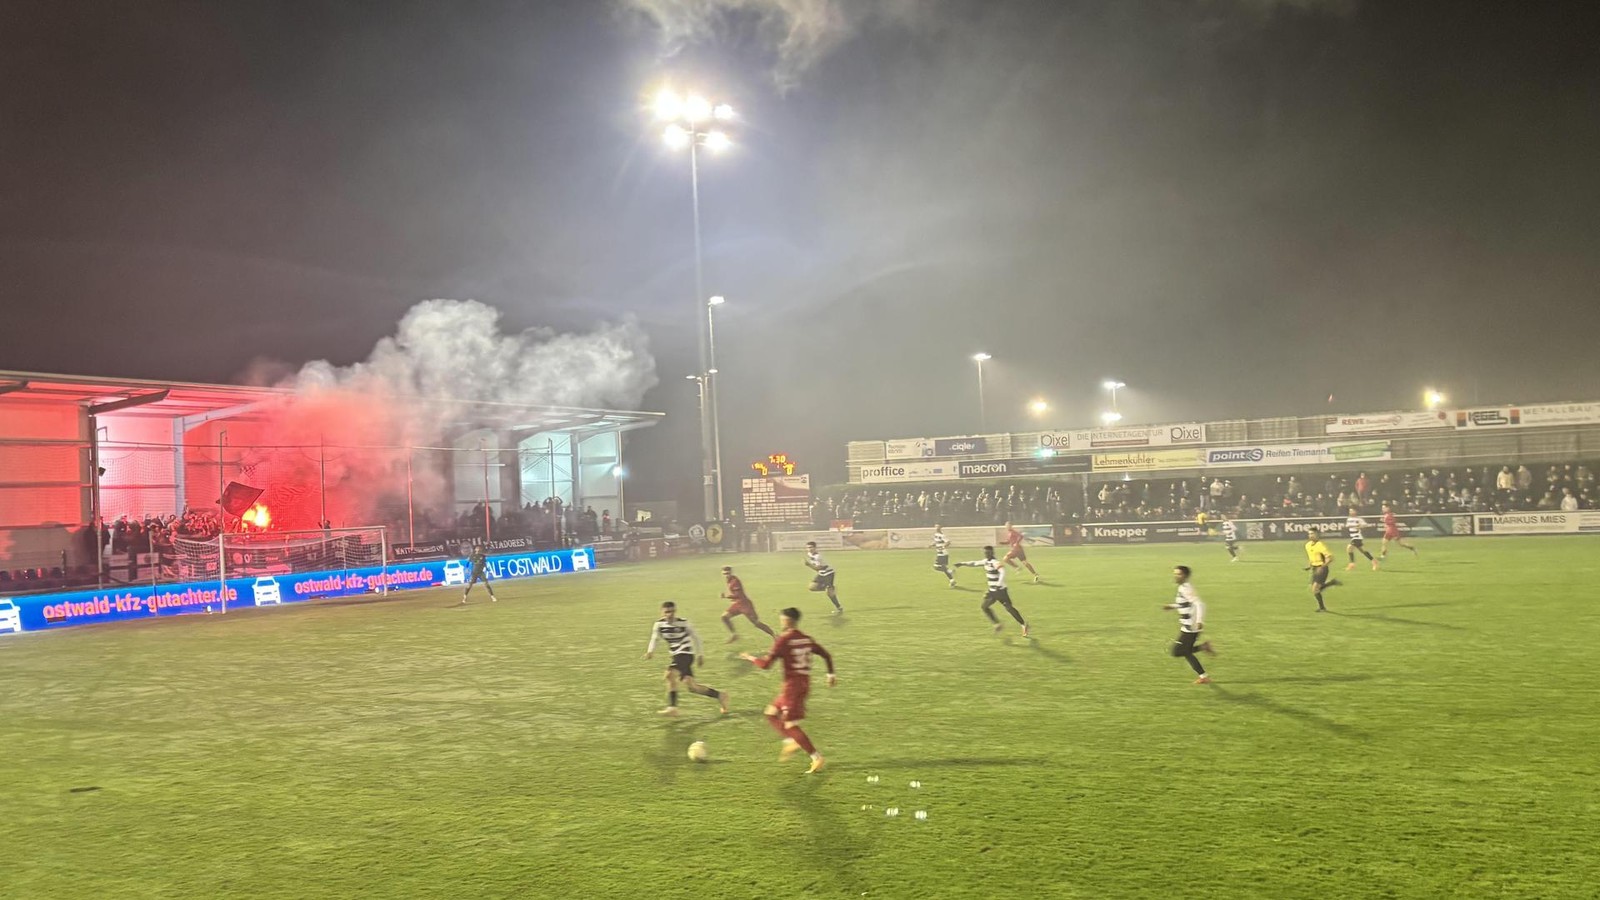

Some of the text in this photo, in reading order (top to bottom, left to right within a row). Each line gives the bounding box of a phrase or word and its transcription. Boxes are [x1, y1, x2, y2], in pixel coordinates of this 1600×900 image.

[1266, 449, 1291, 459] Reifen
[1293, 448, 1327, 457] Tiemann
[862, 466, 905, 479] proffice
[962, 463, 1007, 474] macron
[1494, 514, 1566, 525] MARKUS MIES
[1094, 527, 1148, 537] Knepper
[1285, 522, 1345, 532] Knepper
[507, 555, 562, 577] OSTWALD
[294, 568, 433, 594] ostwald-kfz-gutachter.de
[43, 586, 238, 619] ostwald-kfz-gutachter.de
